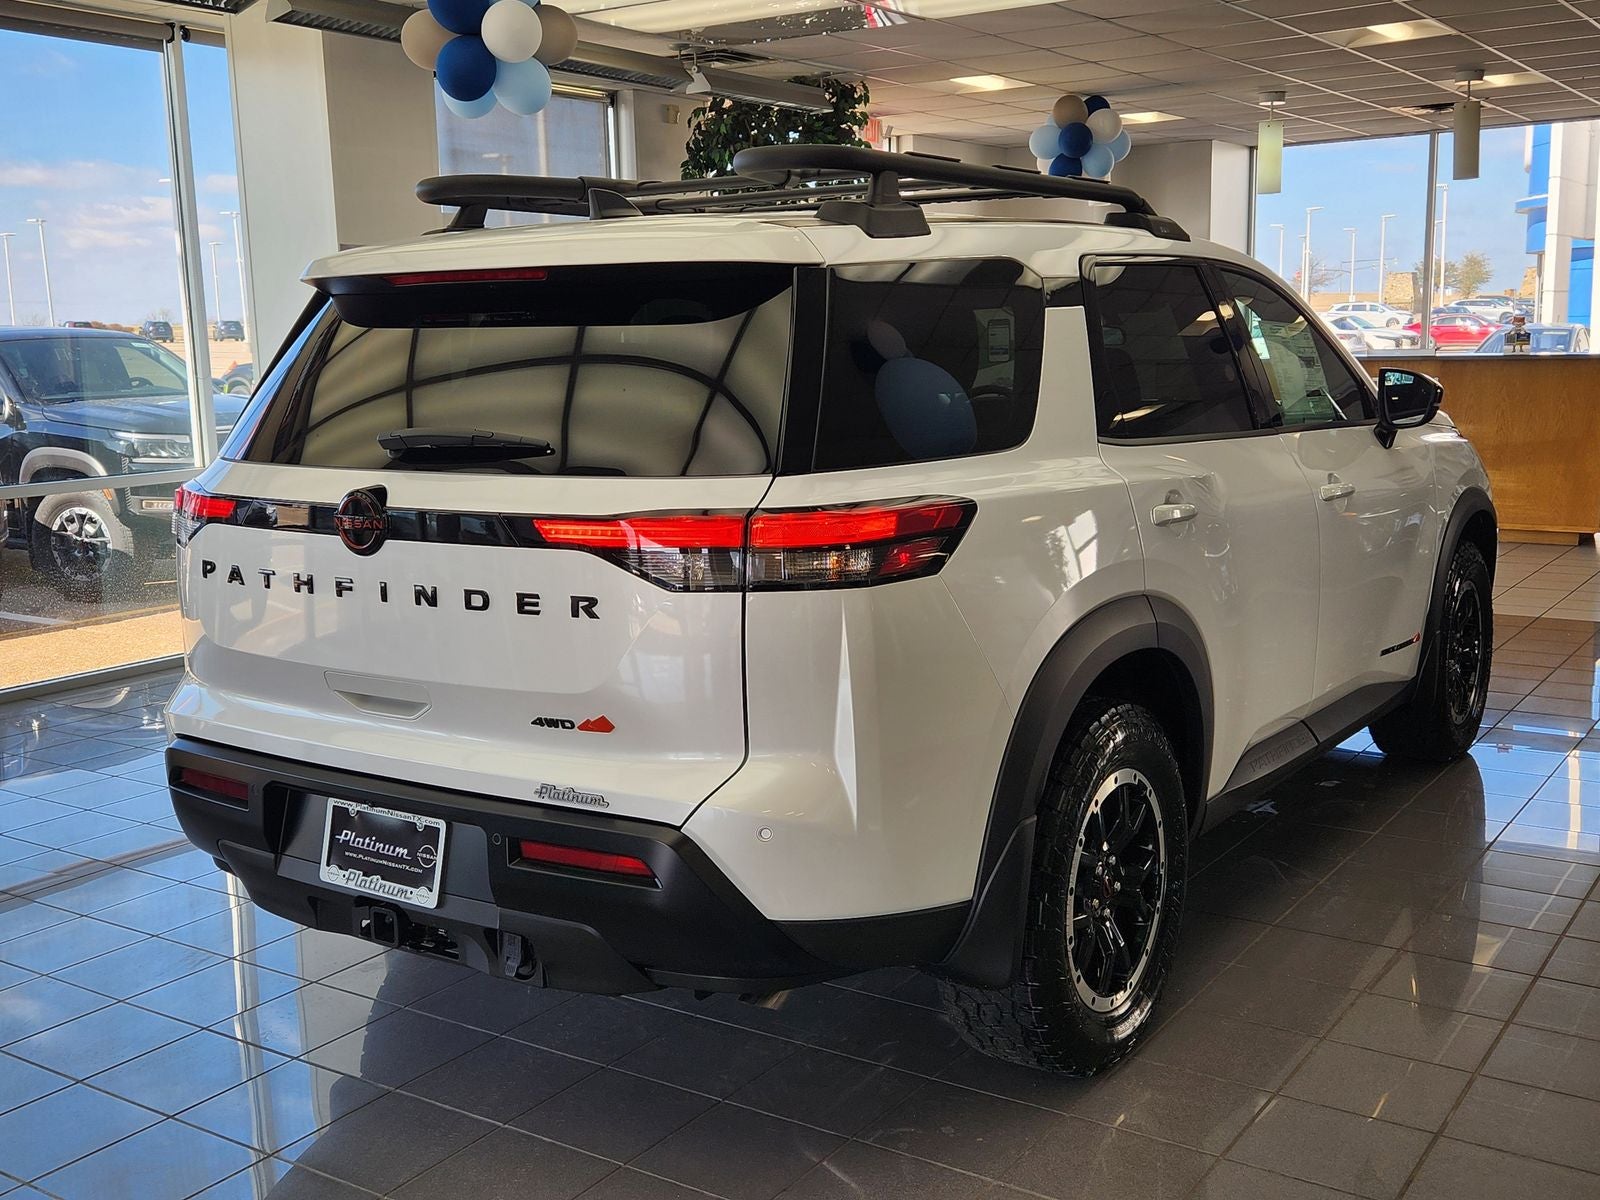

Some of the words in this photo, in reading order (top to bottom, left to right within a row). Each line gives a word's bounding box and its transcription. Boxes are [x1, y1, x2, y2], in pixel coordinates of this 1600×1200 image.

[334, 516, 385, 530] NISSAN
[201, 559, 601, 620] PATHFINDER
[530, 716, 576, 730] 4WD
[534, 783, 610, 808] Platinum
[333, 799, 441, 827] www.PlatinumNissanTX.com
[335, 829, 412, 860] Platinum
[416, 851, 438, 861] NISSAN
[345, 868, 412, 899] Platinum
